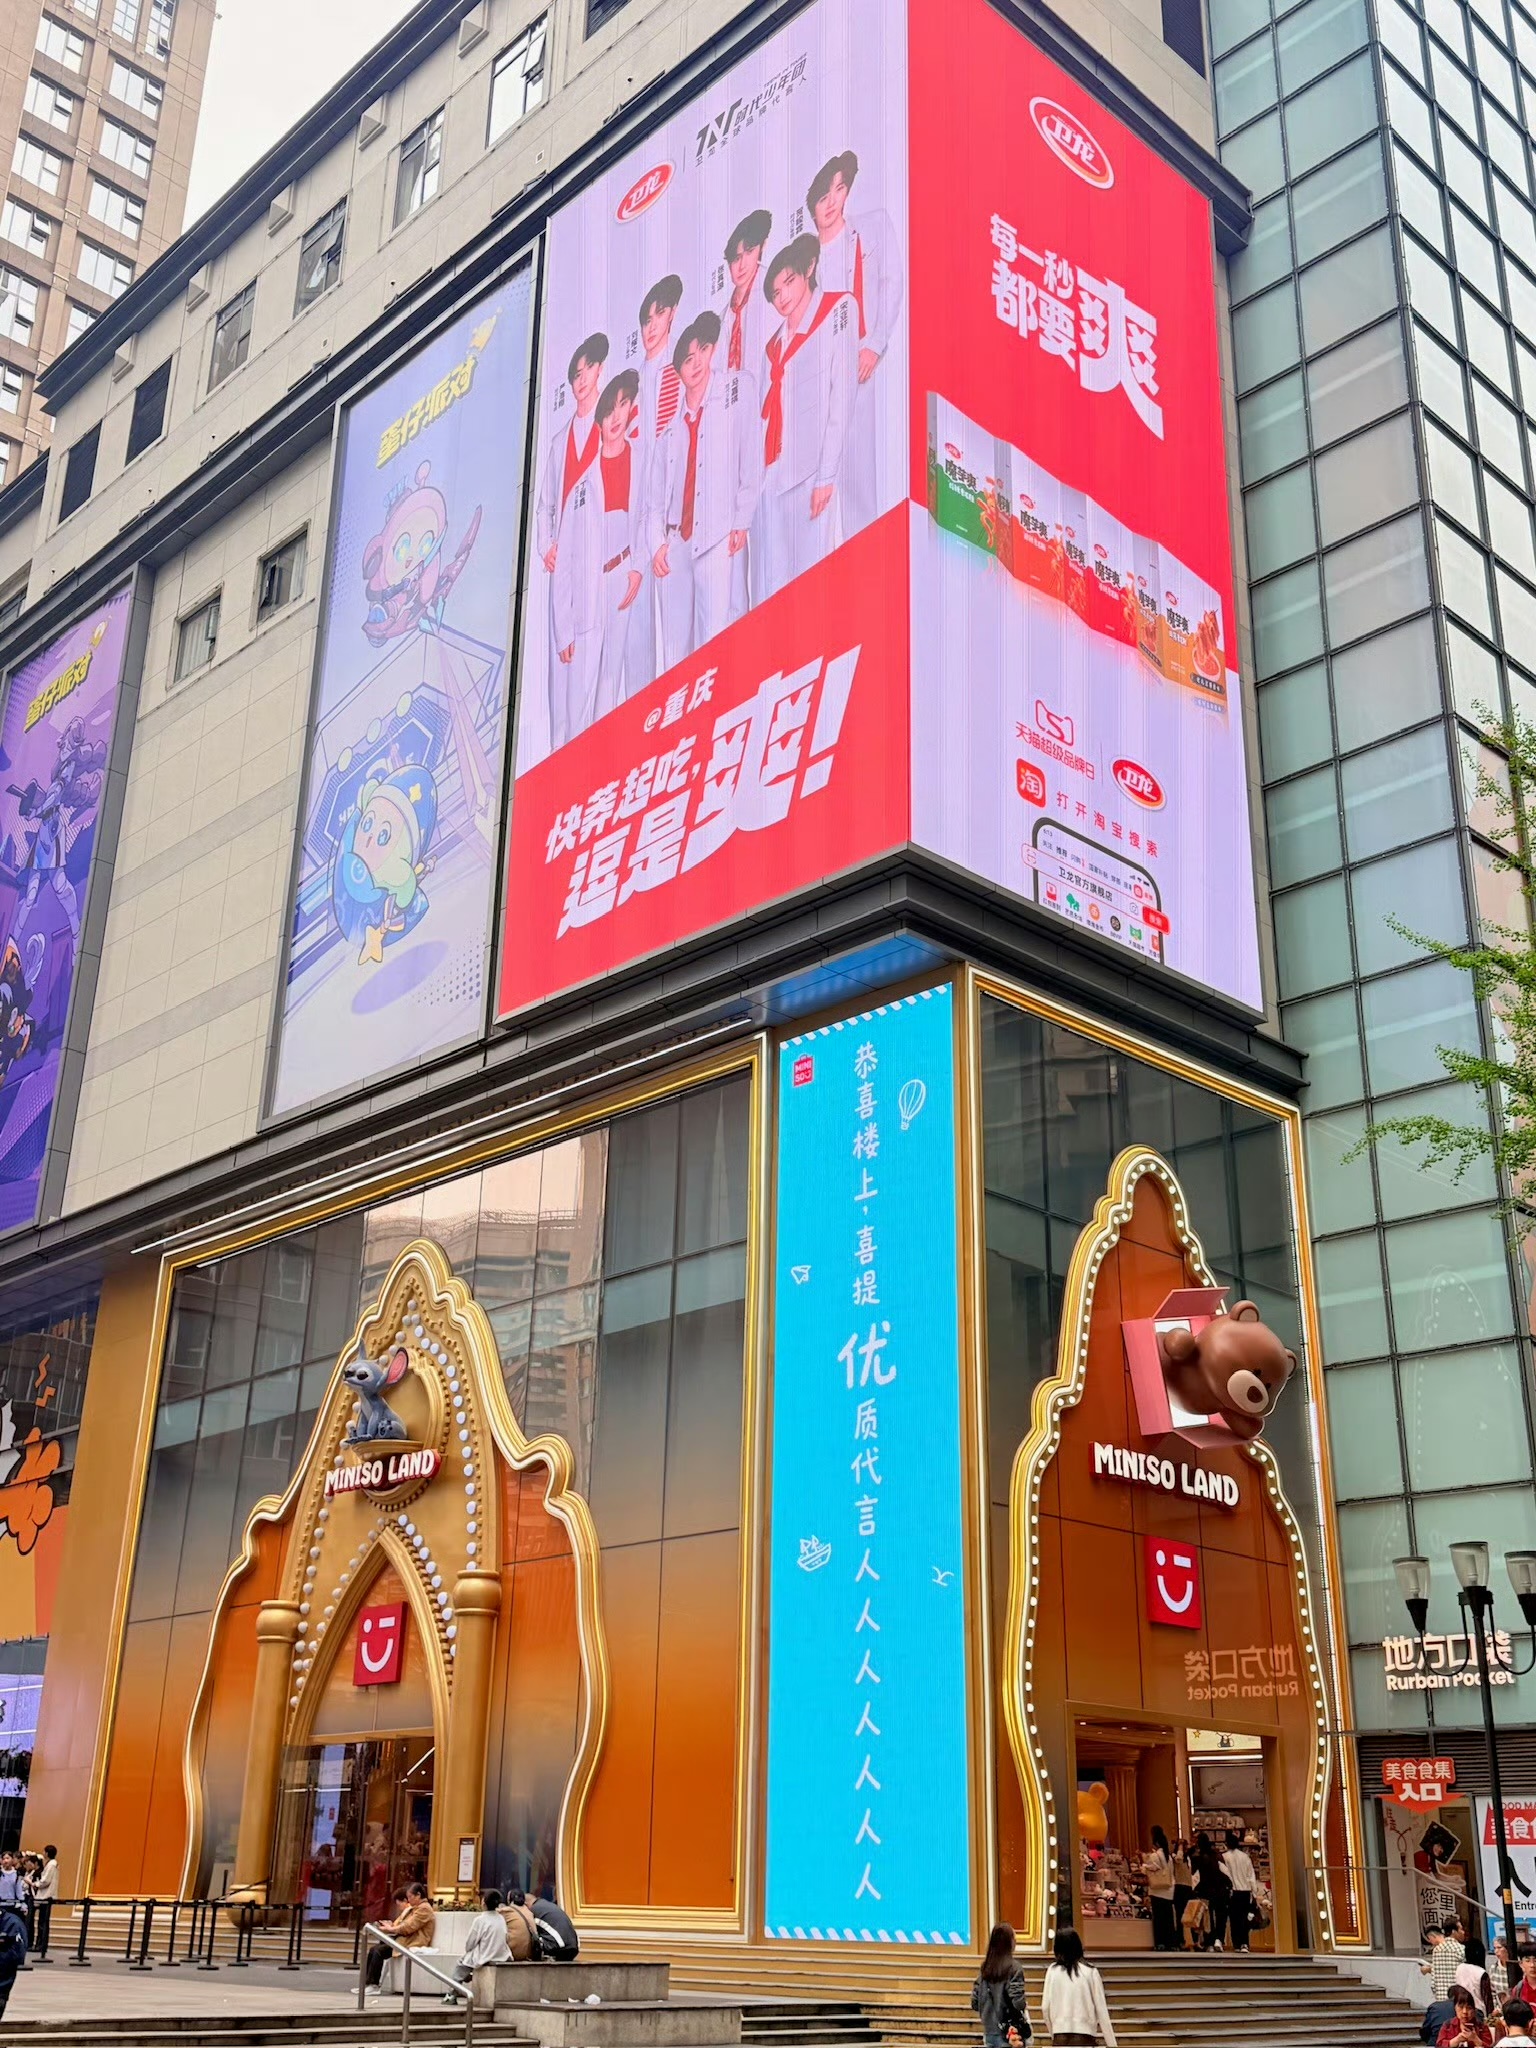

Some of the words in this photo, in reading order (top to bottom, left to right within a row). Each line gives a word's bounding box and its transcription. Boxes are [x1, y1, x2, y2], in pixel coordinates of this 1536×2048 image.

[1042, 115, 1100, 174] 卫龙
[624, 170, 665, 215] 卫龙
[990, 213, 1074, 300] 每一秒
[945, 459, 977, 491] 魔芋爽
[643, 666, 719, 733] @重庆
[1015, 721, 1096, 781] 天猫超级品牌日
[1020, 768, 1043, 799] 淘
[1117, 767, 1157, 802] 卫龙
[1057, 790, 1160, 858] 打开淘宝搜索
[1058, 866, 1113, 902] 卫龙官方旗舰店
[795, 1060, 812, 1073] MINI
[324, 1459, 383, 1495] MINISO
[389, 1449, 437, 1481] LAND
[1094, 1441, 1175, 1490] MINISO
[1181, 1462, 1240, 1507] LAND
[1386, 1672, 1450, 1690] Rurban
[1385, 1761, 1452, 1781] 美食食集
[1399, 1783, 1442, 1801] 入口
[1515, 1901, 1536, 1911] Entr
